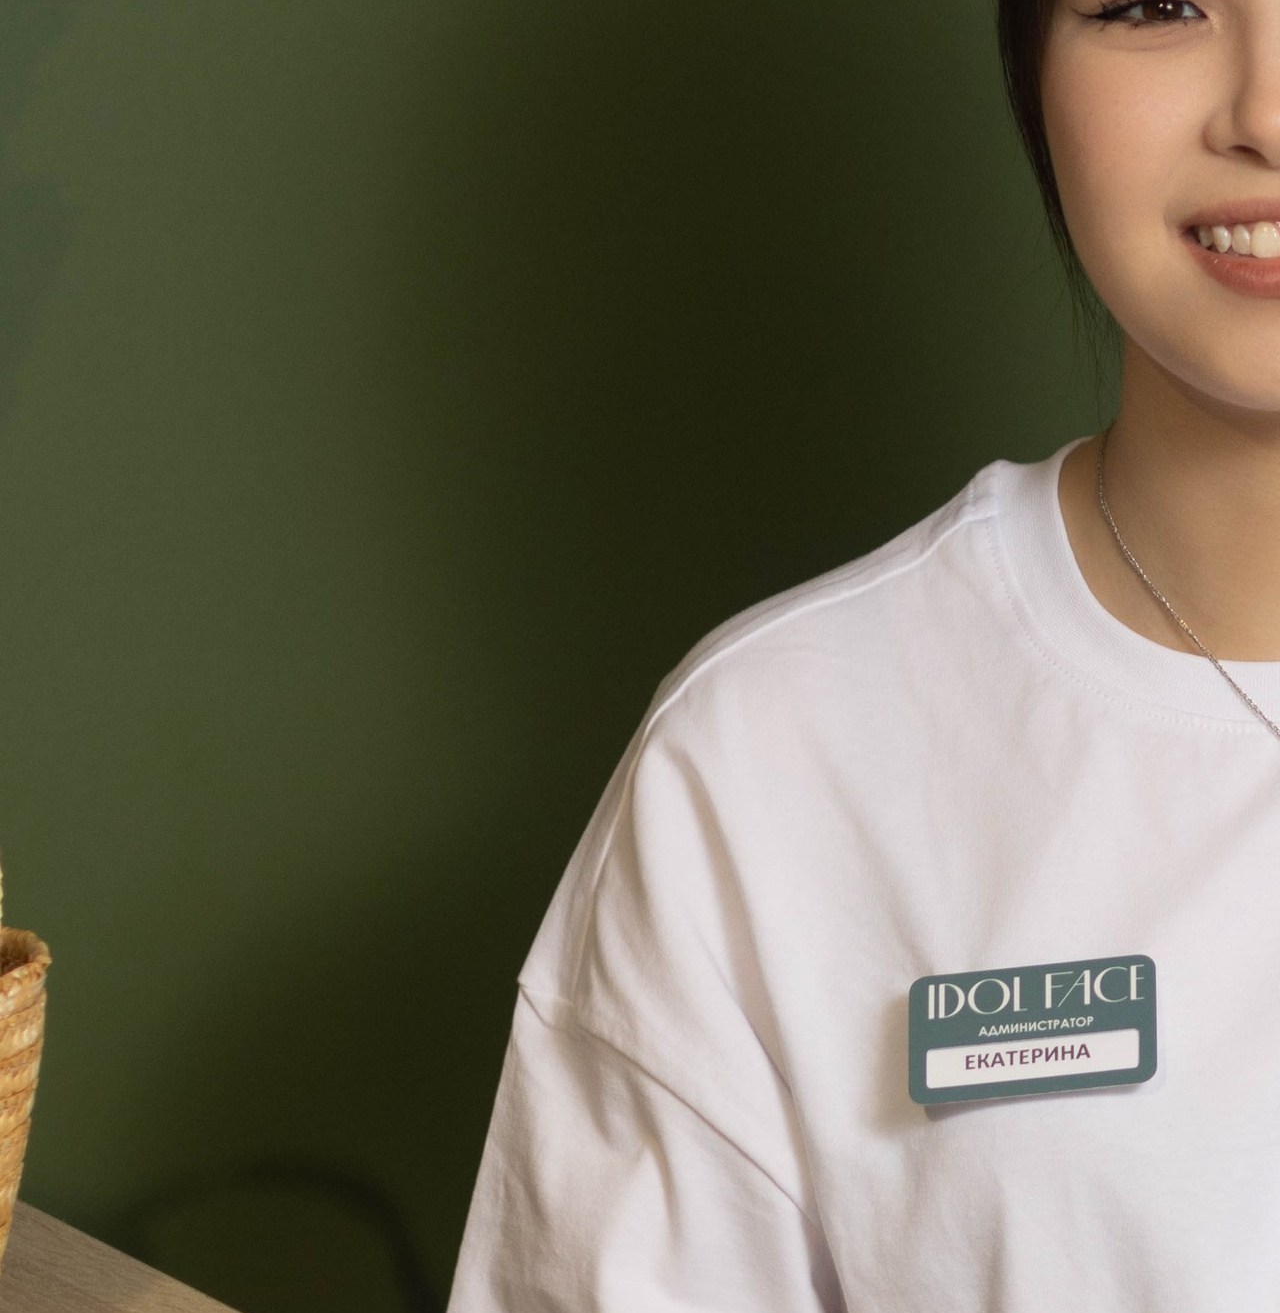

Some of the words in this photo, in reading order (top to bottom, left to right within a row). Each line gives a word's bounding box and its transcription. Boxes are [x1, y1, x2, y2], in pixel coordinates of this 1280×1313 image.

[927, 976, 1028, 1020] IDOL
[1045, 964, 1145, 1009] FACE
[978, 1016, 1094, 1037] АДМИНИСТРАТОР
[965, 1043, 1091, 1070] ЕКАТЕРИНА
